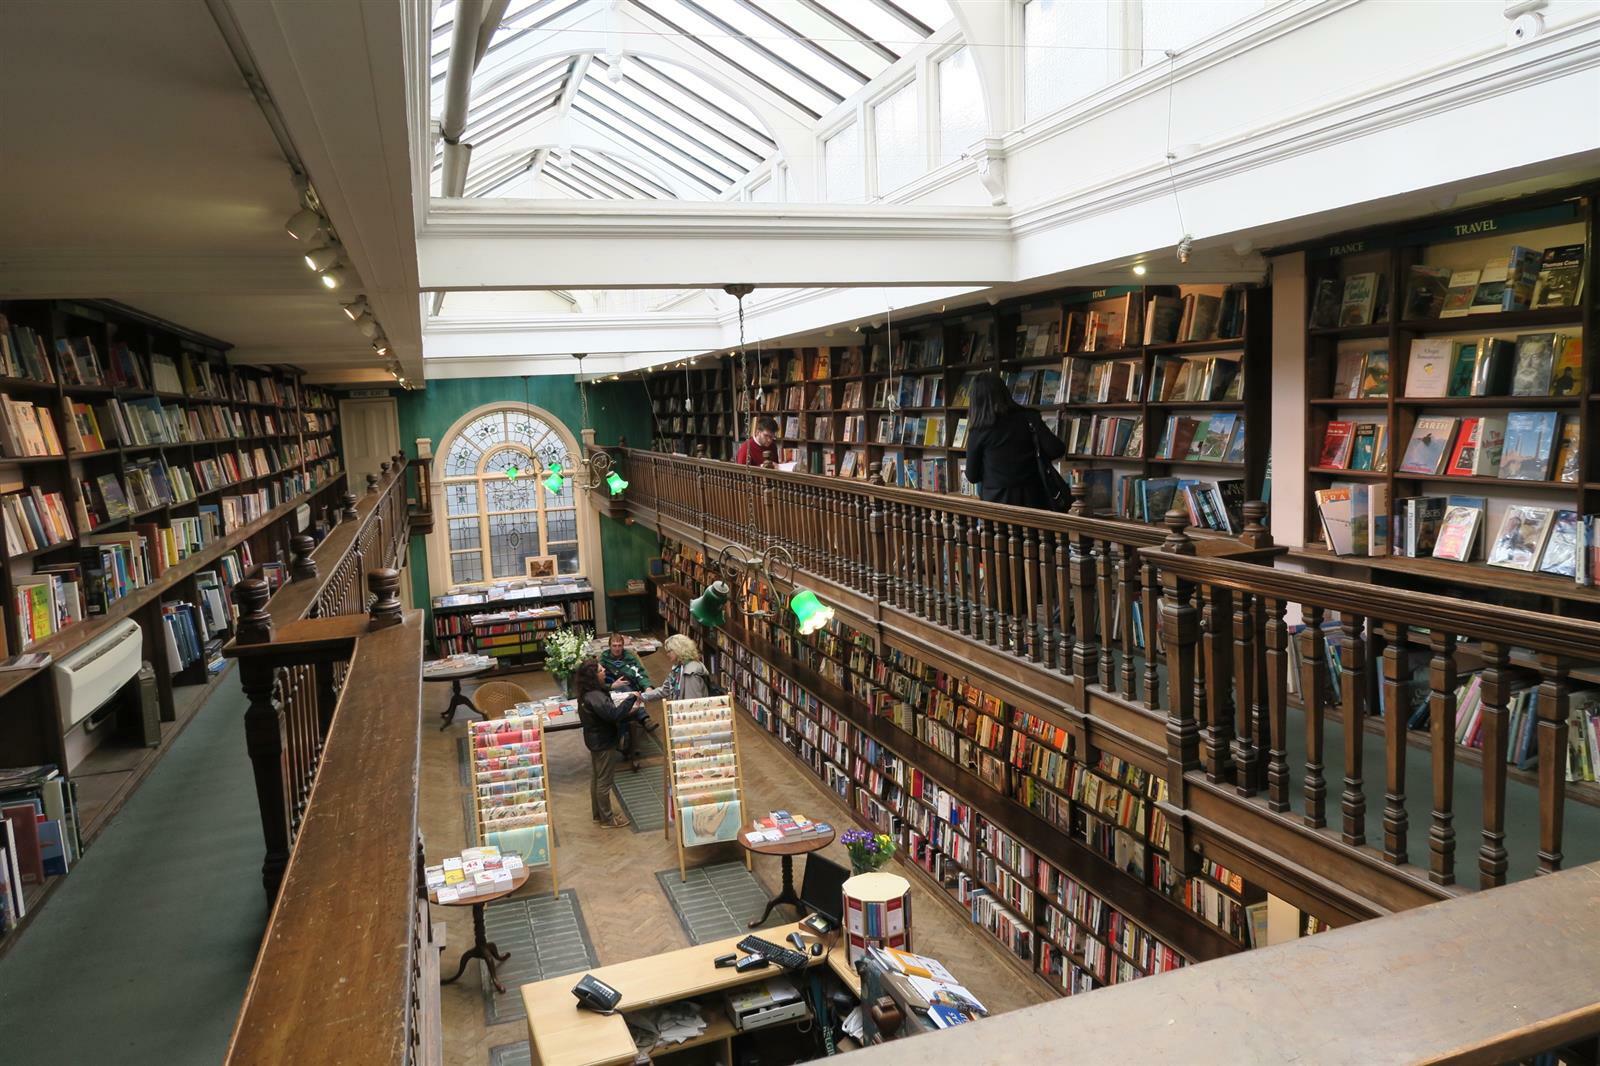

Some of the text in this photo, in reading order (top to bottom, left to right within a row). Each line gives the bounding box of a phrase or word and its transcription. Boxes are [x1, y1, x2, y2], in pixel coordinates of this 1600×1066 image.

[1454, 219, 1497, 236] TRAVEL
[1329, 241, 1364, 256] FRANCE
[1418, 420, 1448, 430] EARTH
